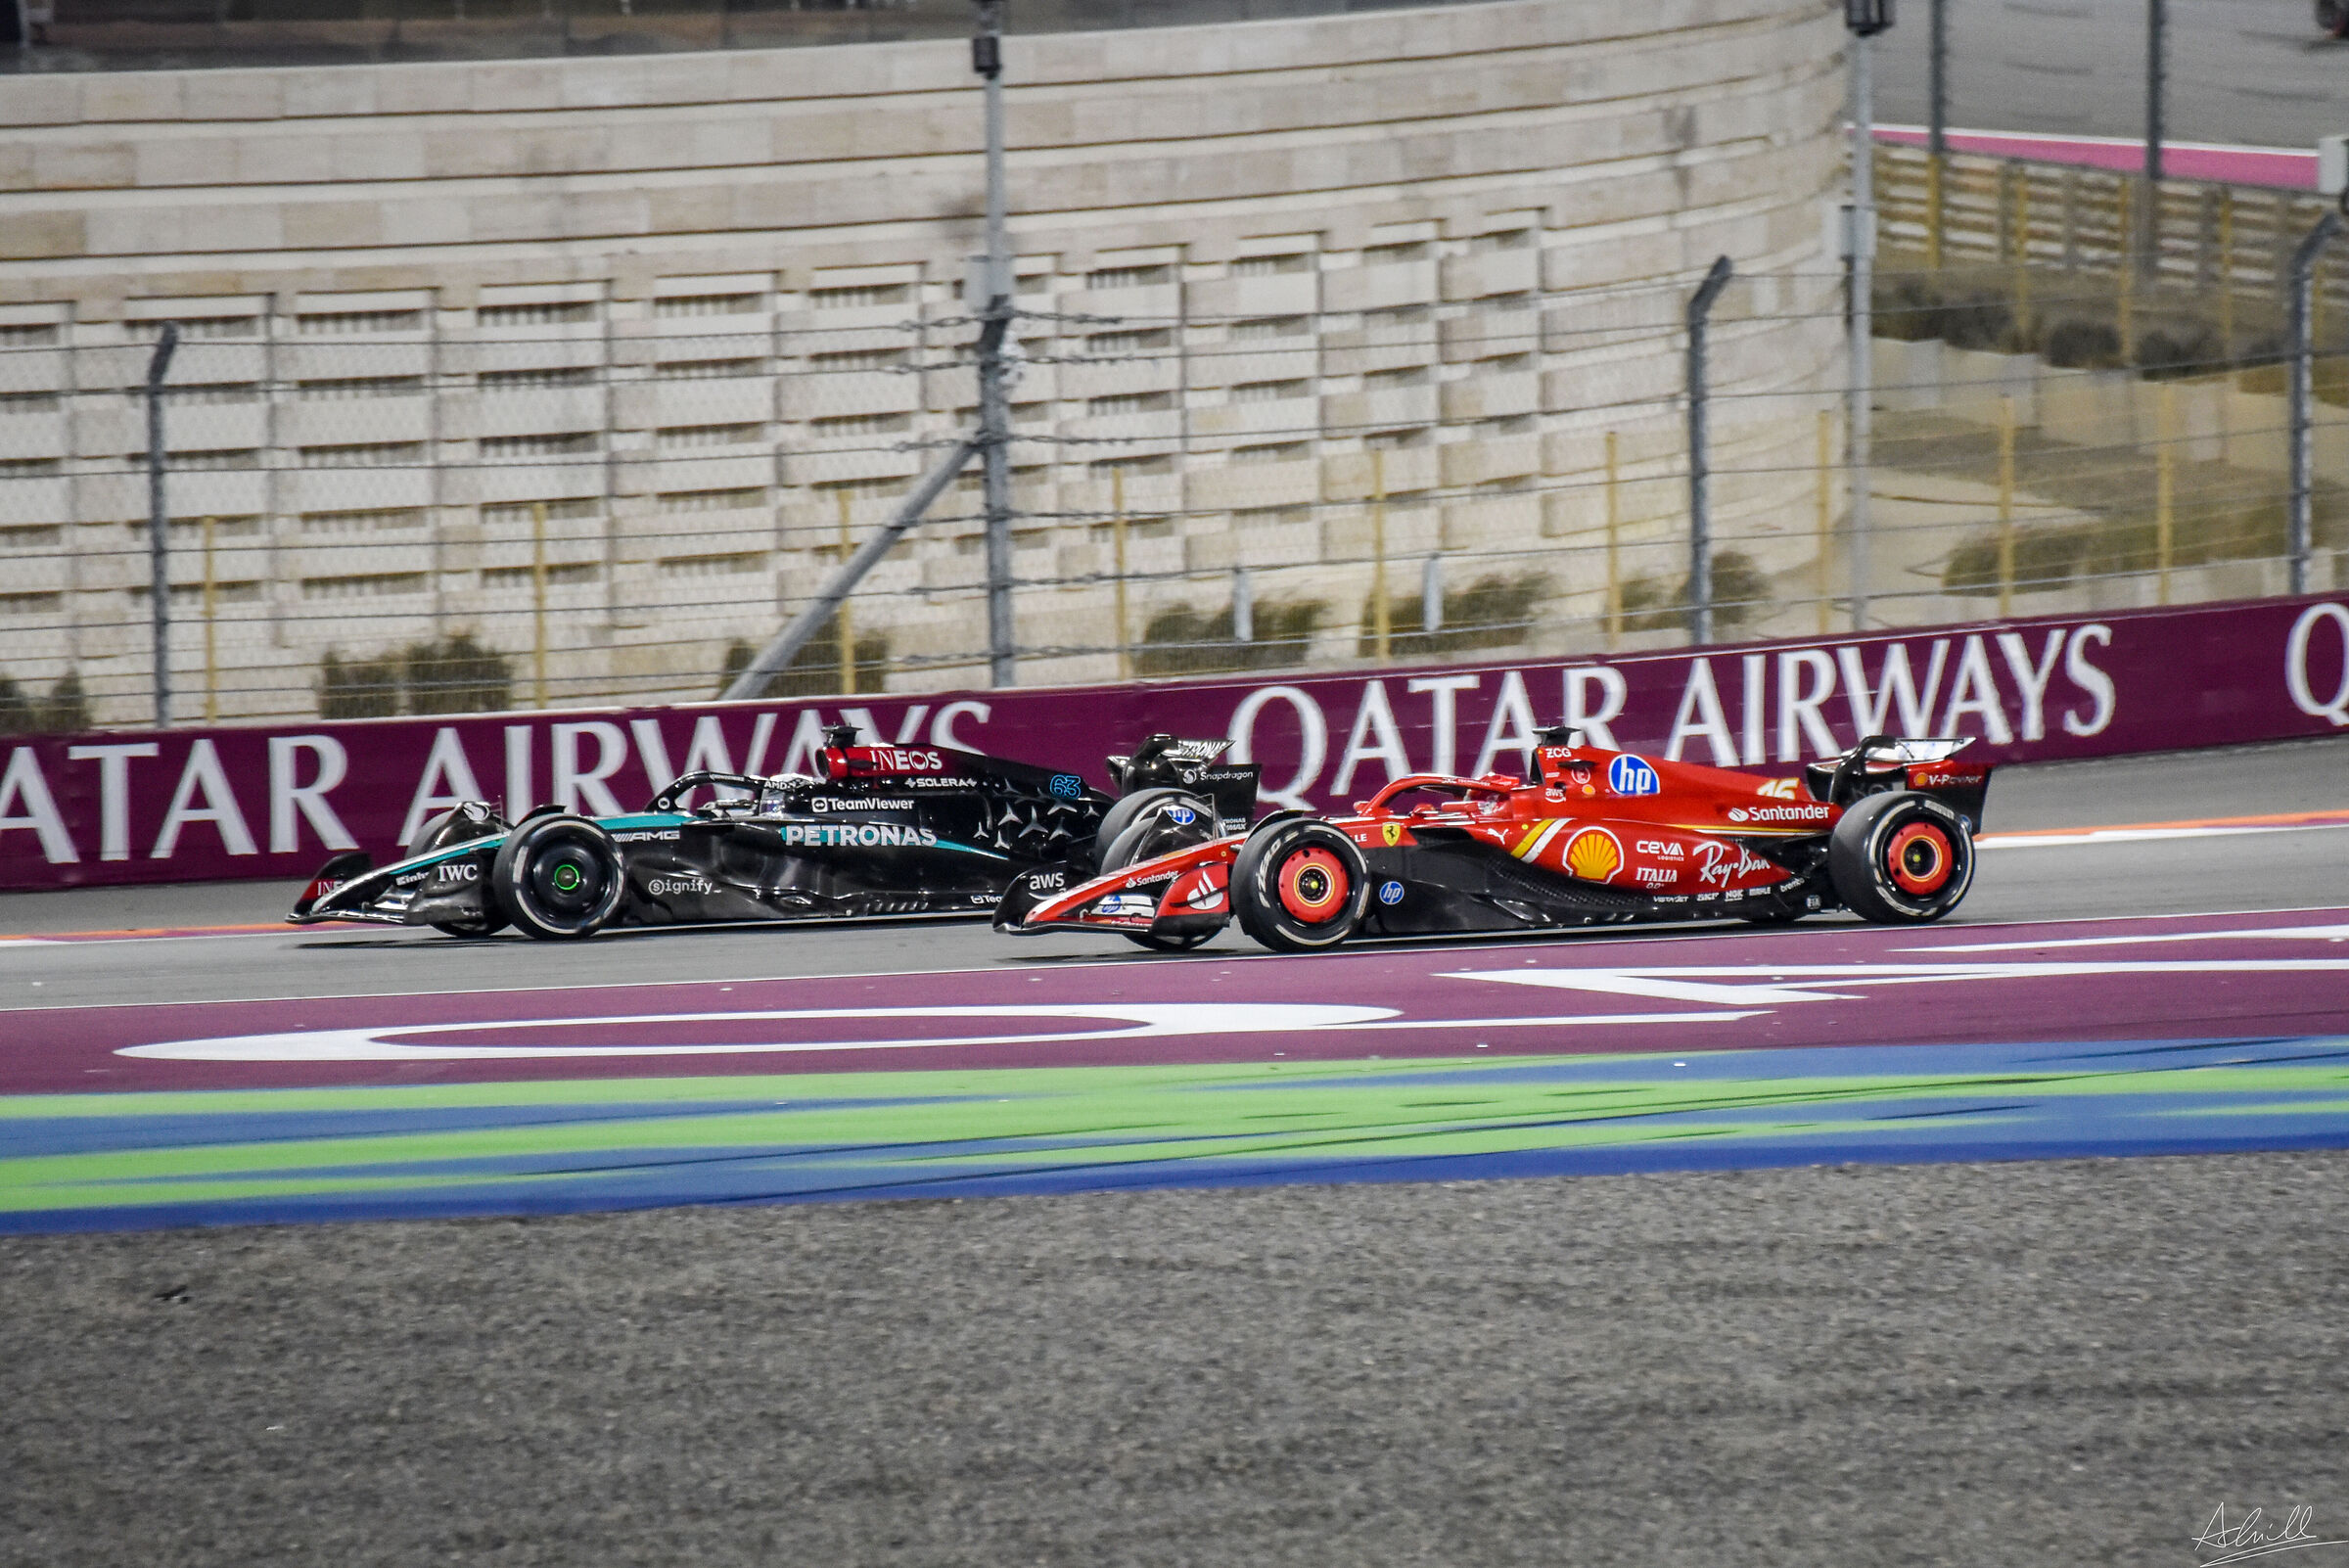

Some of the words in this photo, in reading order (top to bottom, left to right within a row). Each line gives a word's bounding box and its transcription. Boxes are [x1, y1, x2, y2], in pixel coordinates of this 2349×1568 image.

[2284, 602, 2349, 726] Q
[1226, 666, 1628, 811] QATAR
[1665, 623, 2117, 767] AIRWAYS
[870, 750, 943, 771] INEOS
[1544, 748, 1571, 759] ZCG
[916, 777, 969, 788] SOLERA
[1200, 769, 1254, 782] Snapdragon
[1619, 758, 1652, 795] hp
[1049, 774, 1082, 799] 63
[1545, 788, 1563, 798] aws
[829, 797, 914, 811] TeamViewer
[1748, 805, 1830, 821] Santander
[631, 830, 680, 842] AMG
[785, 825, 938, 848] PETRONAS
[438, 864, 479, 882] IWC
[1029, 872, 1065, 890] aws
[1635, 867, 1678, 883] ITALIA
[1383, 883, 1403, 904] hp
